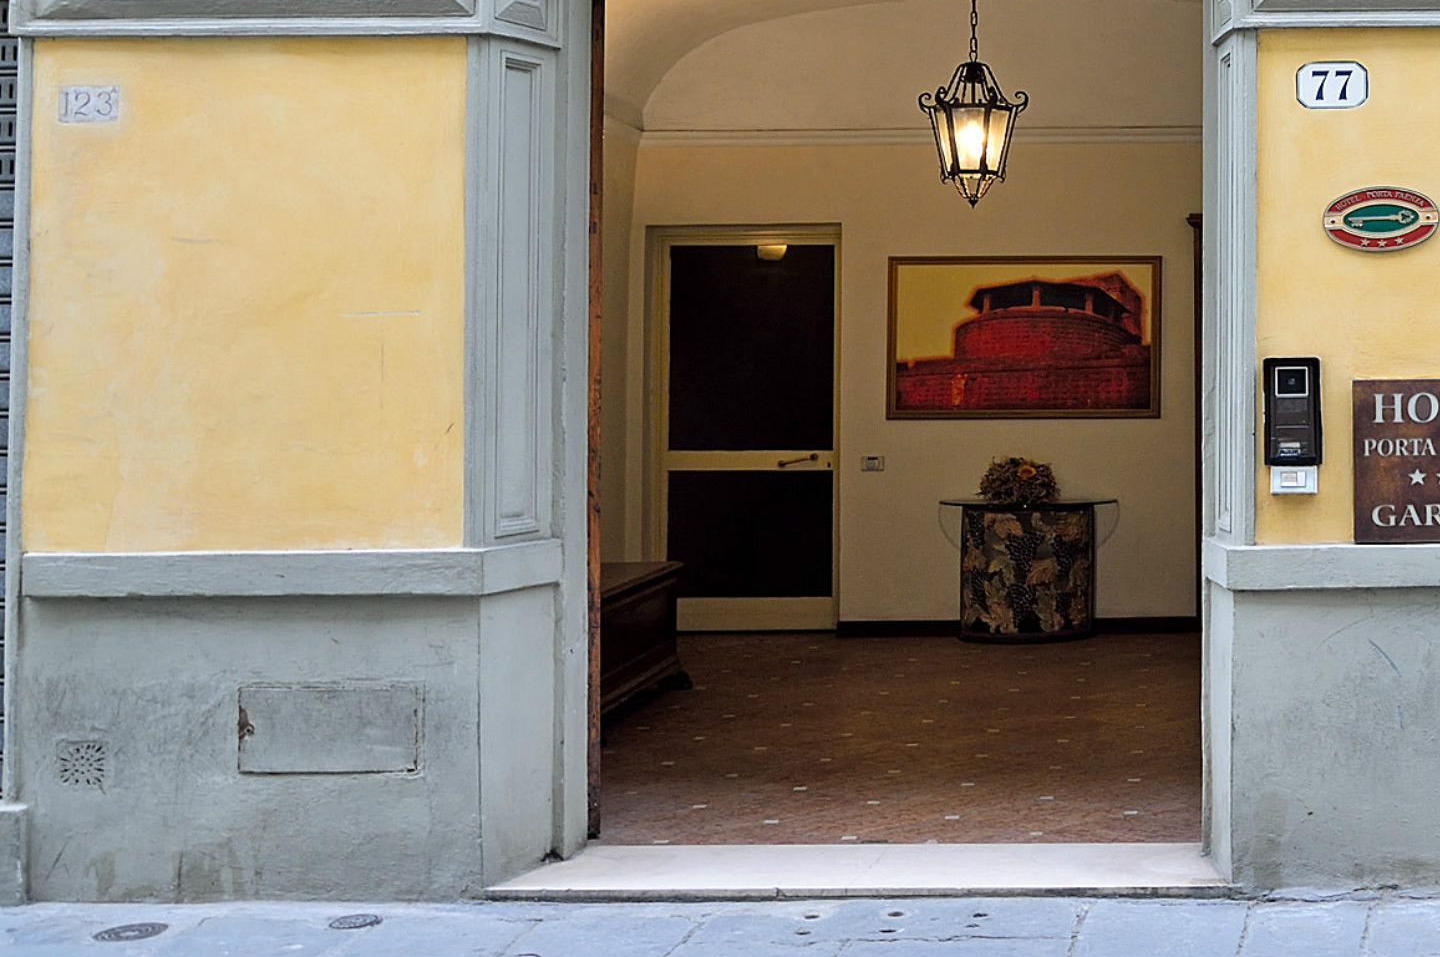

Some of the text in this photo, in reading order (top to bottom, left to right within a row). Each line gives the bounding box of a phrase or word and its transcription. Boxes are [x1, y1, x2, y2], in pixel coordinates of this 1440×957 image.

[1311, 70, 1353, 101] 77
[1335, 190, 1425, 211] HOTEL PORTA FAENZA
[1363, 438, 1437, 457] PORTA
